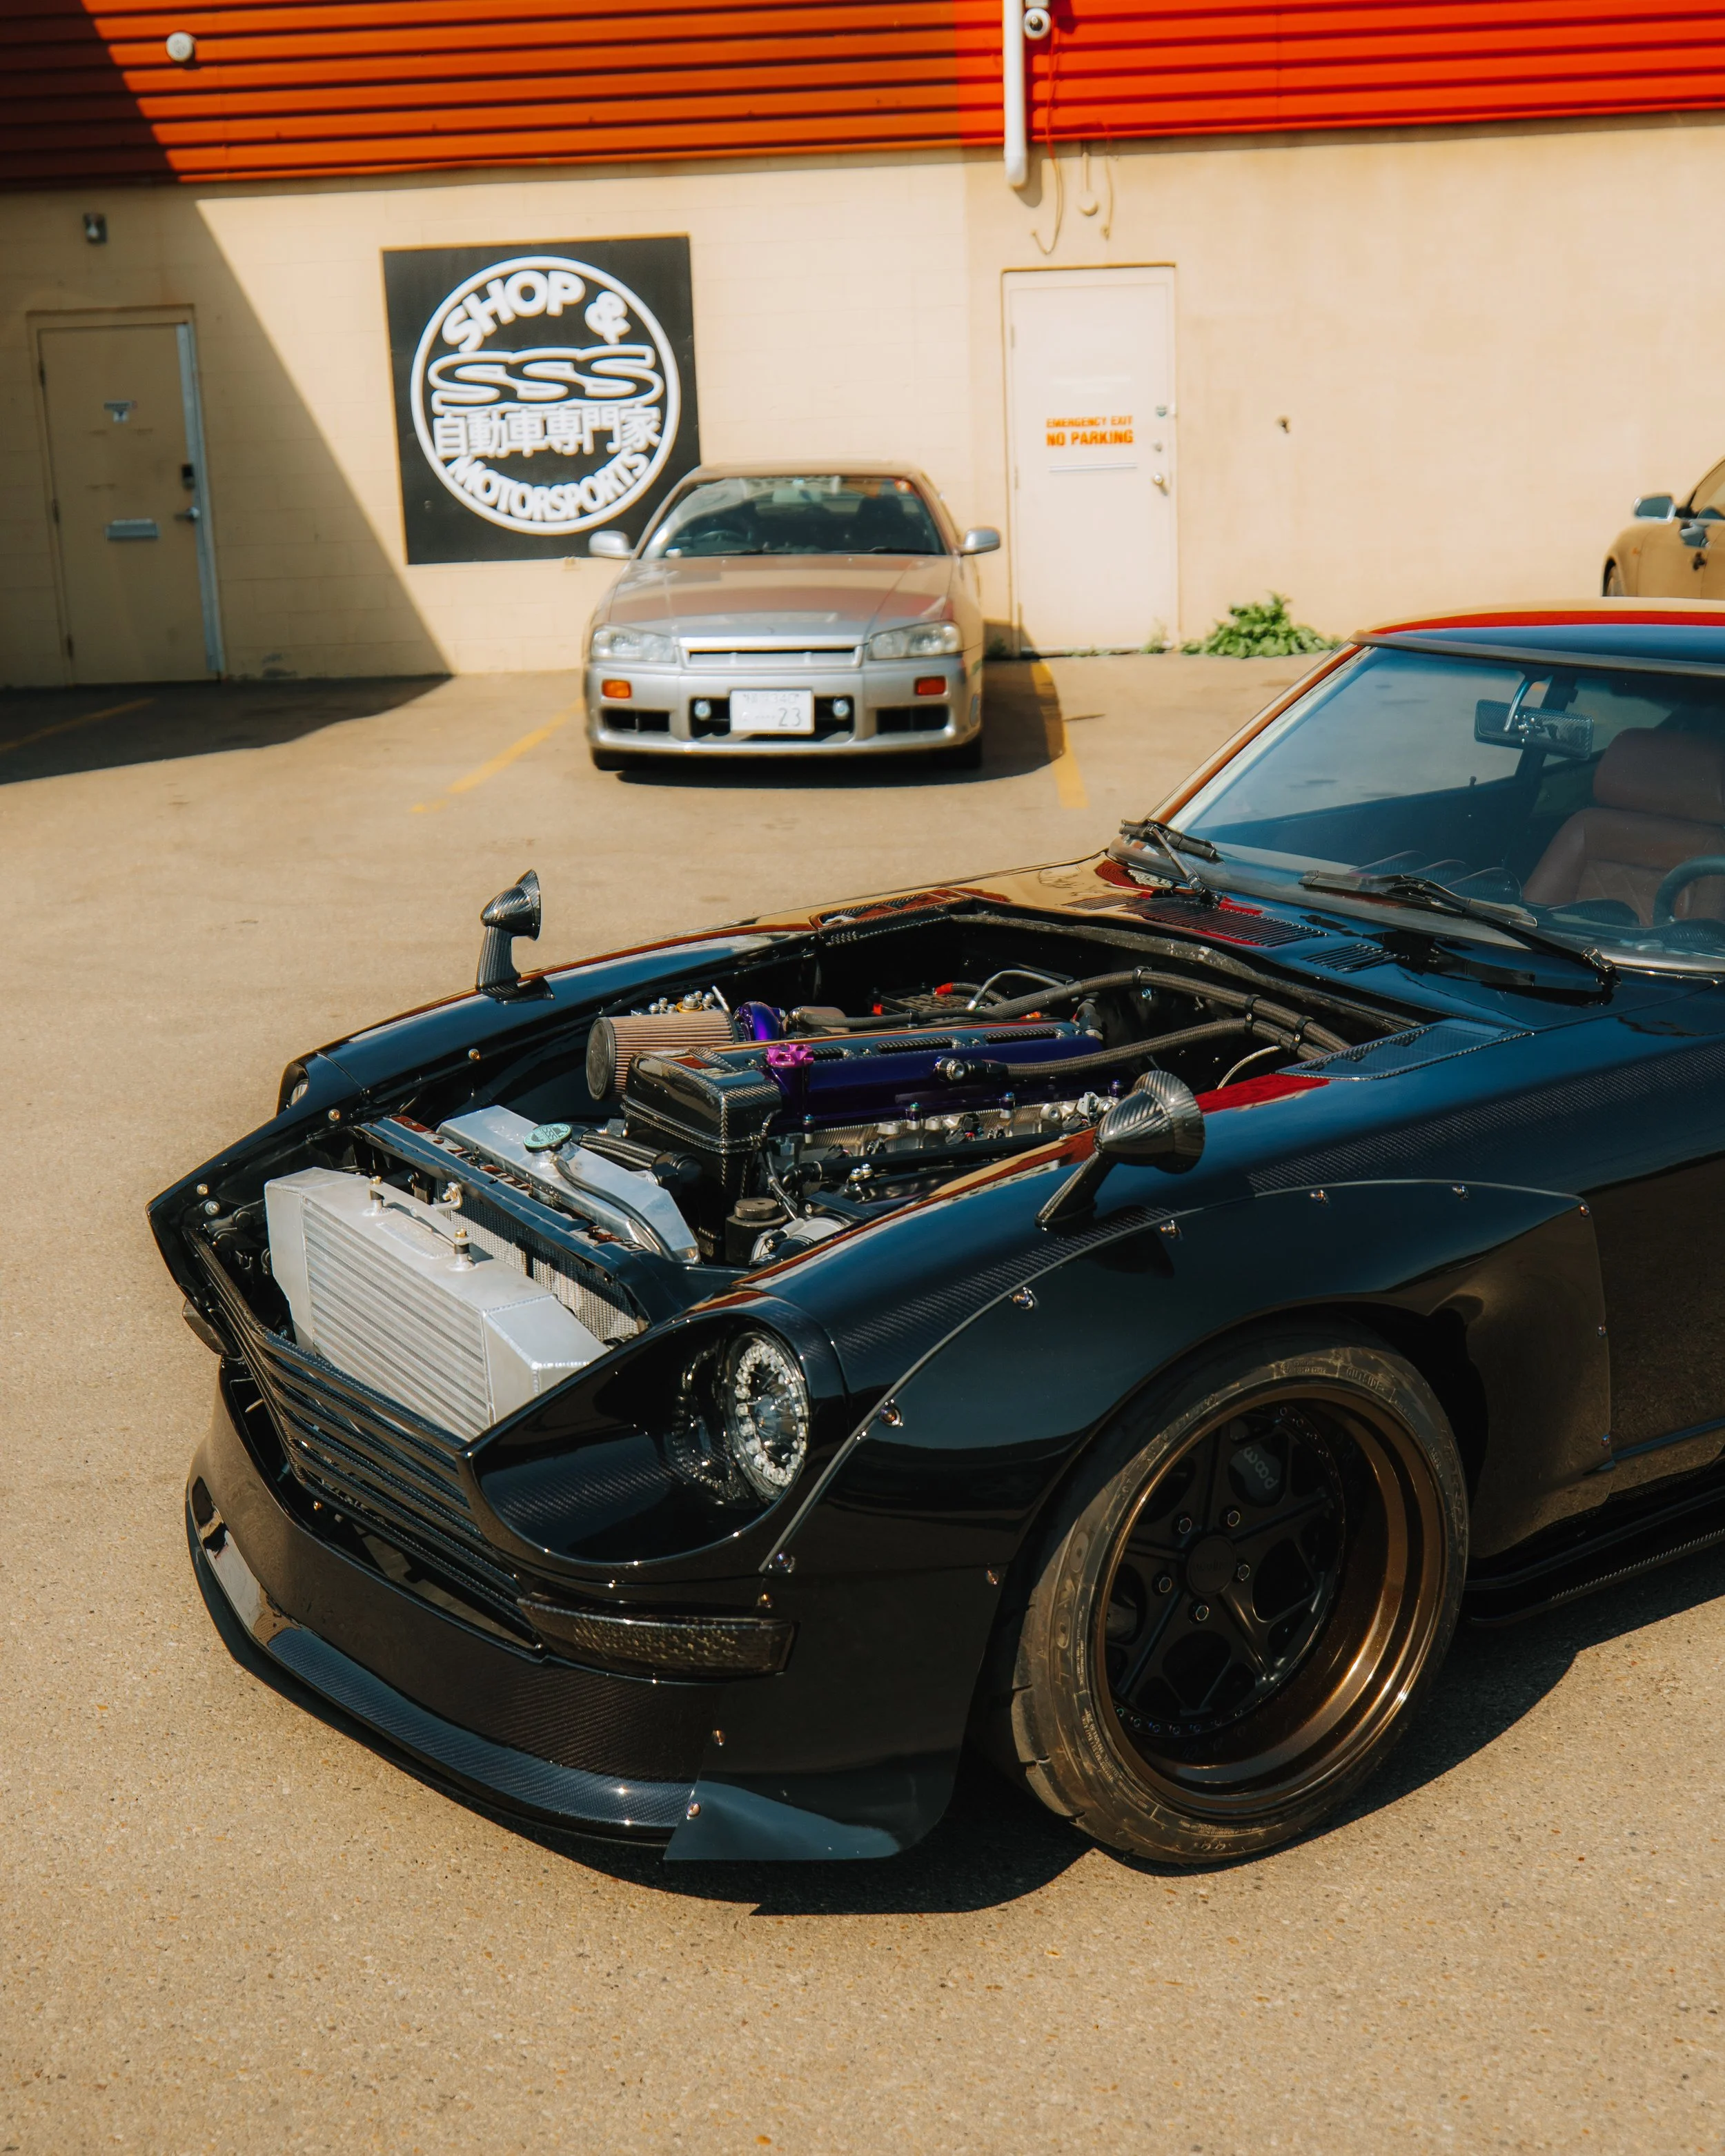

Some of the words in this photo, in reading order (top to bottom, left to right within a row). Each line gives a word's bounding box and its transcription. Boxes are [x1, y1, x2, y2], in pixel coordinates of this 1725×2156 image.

[442, 270, 586, 353] SHOP
[584, 290, 631, 344] &
[428, 344, 664, 414] SSS
[1046, 416, 1107, 428] EMERGENCY
[1110, 415, 1133, 426] EXIT
[1046, 432, 1065, 446] NO
[1071, 429, 1134, 446] PARKING
[446, 451, 650, 521] MOTORSPORTS
[778, 707, 801, 727] 23
[1054, 1530, 1090, 1686] TOYO
